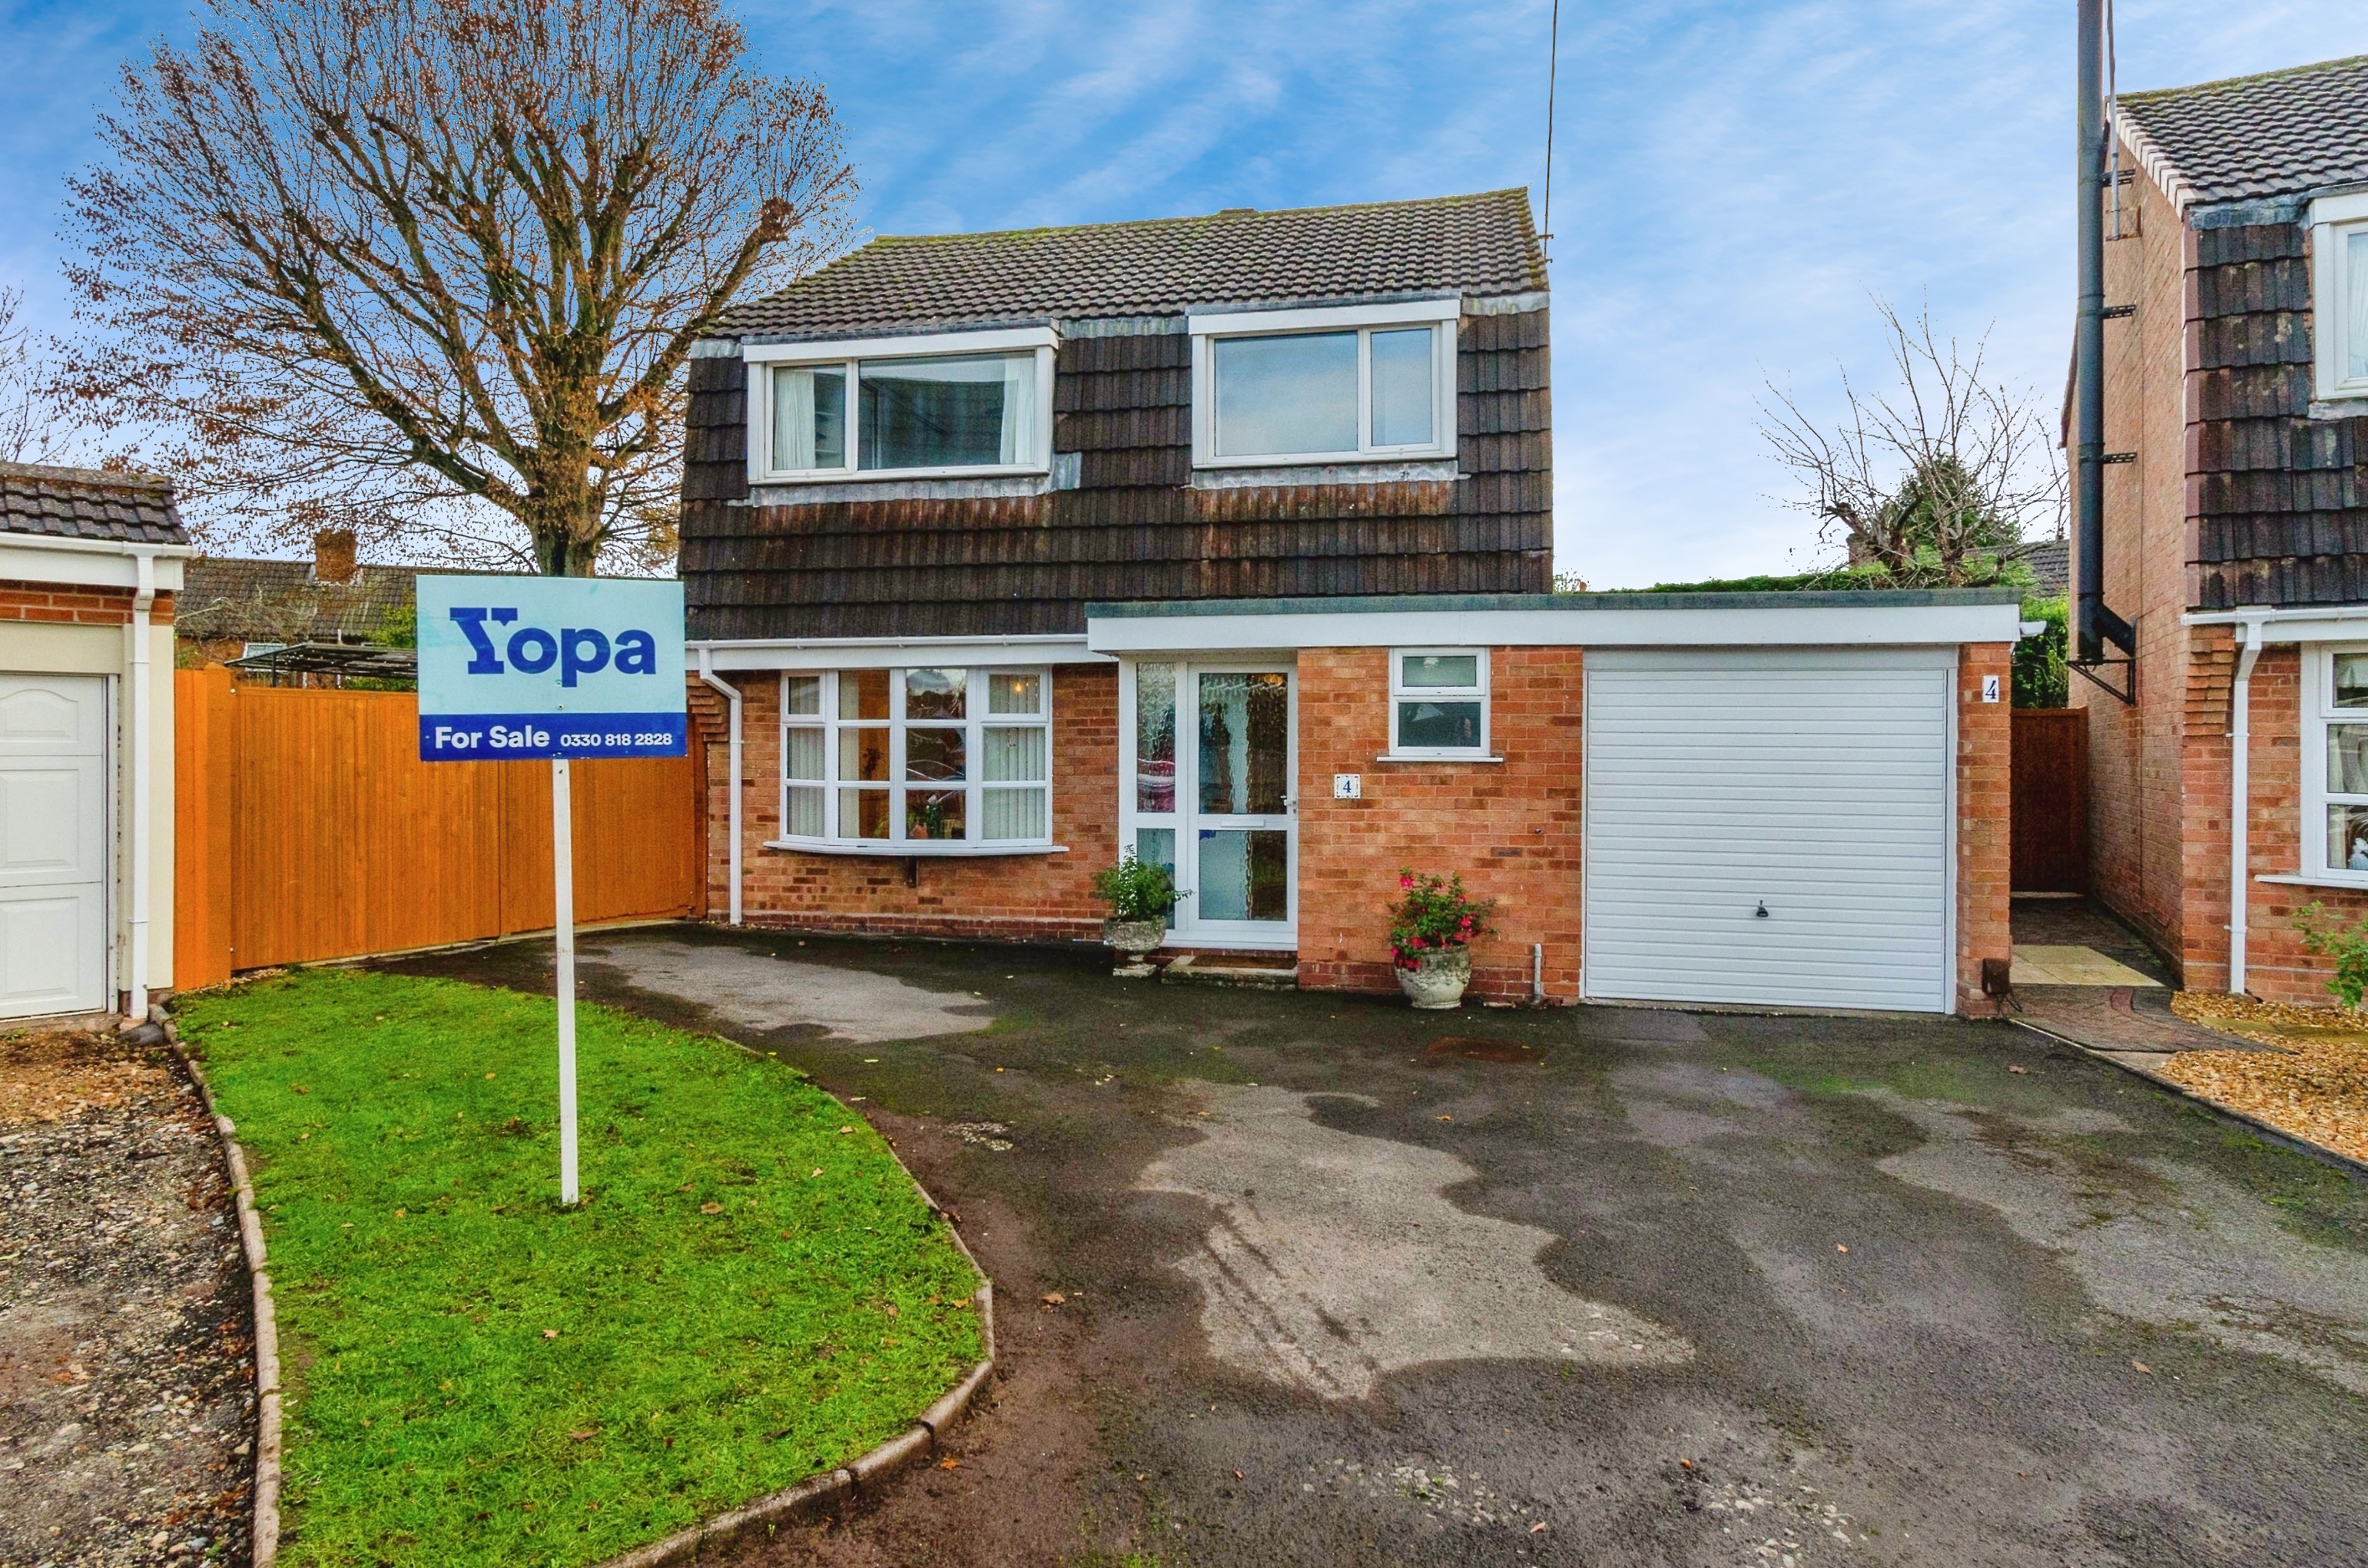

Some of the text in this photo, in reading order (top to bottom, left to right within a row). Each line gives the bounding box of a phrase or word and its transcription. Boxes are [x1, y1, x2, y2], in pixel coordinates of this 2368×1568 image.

[449, 608, 656, 688] Yopa
[1985, 680, 1997, 699] 4
[435, 725, 672, 749] For Sale 0330 818 2828
[1342, 780, 1351, 794] 4
